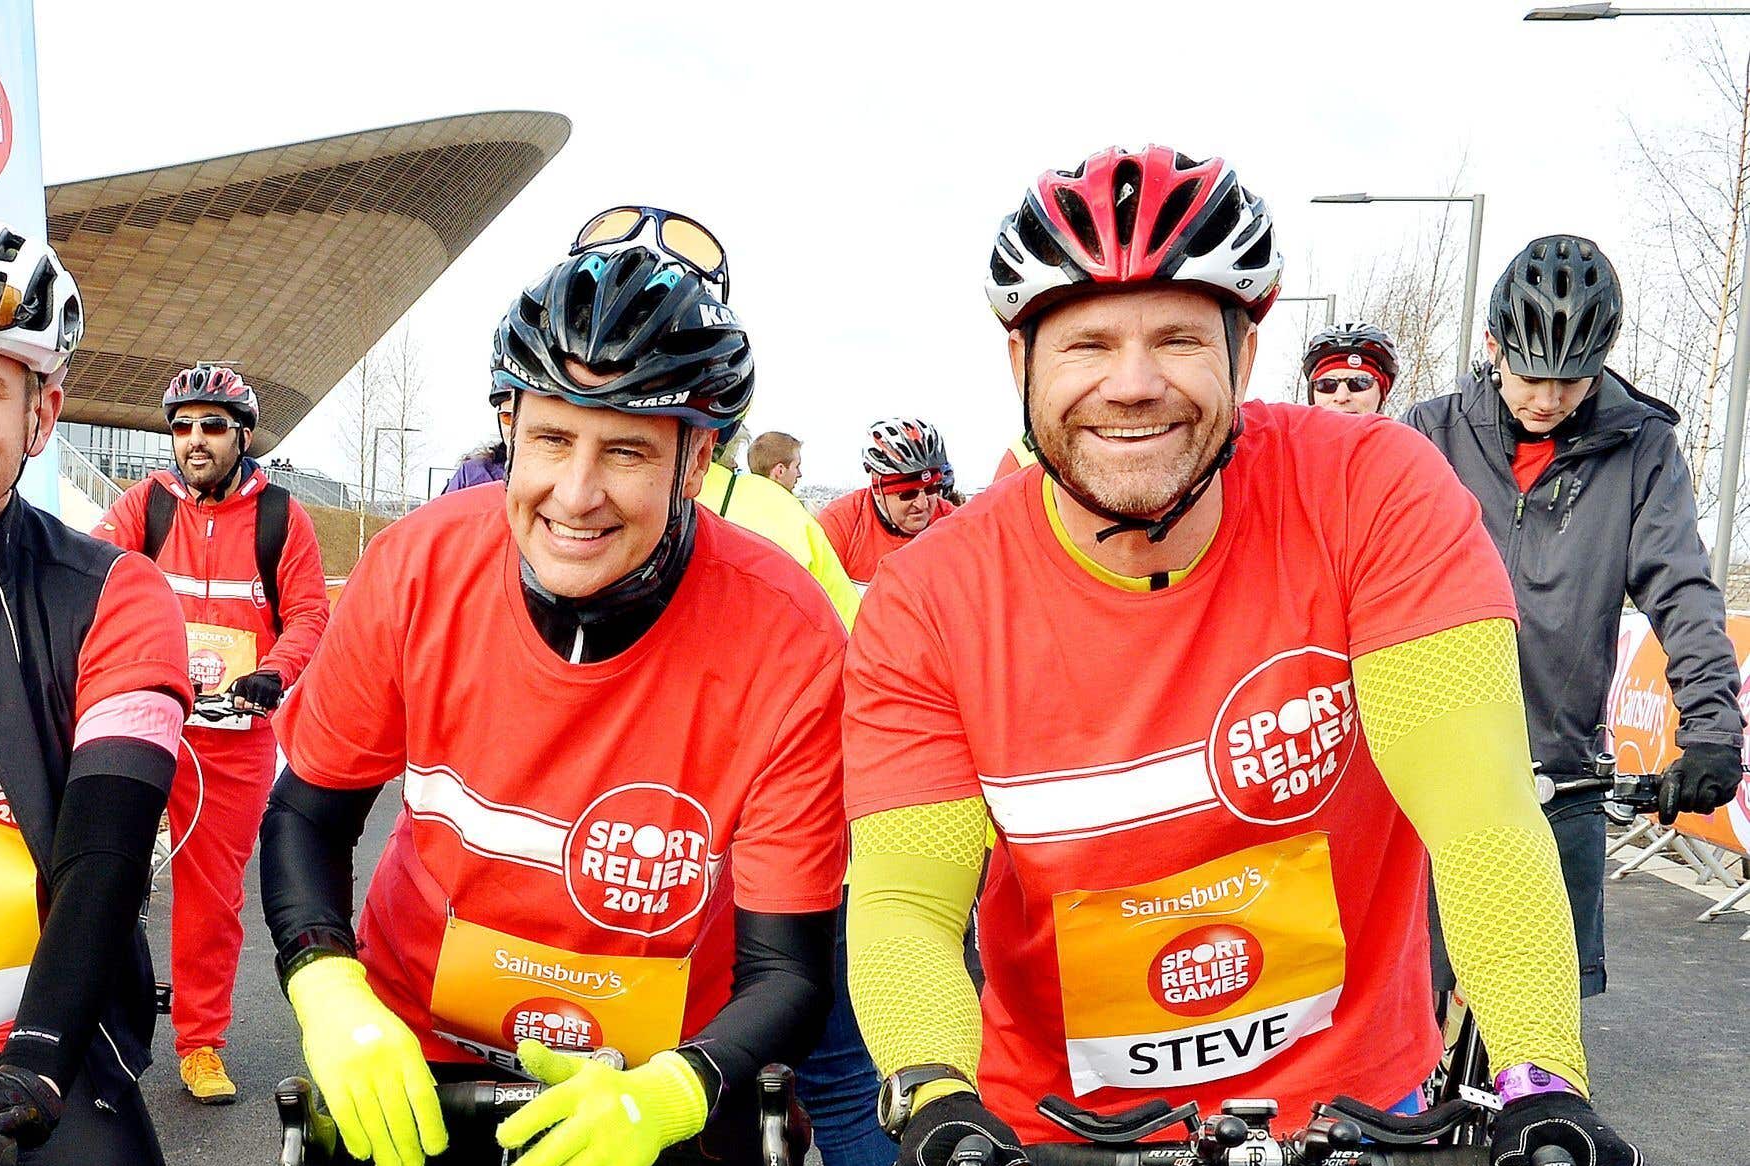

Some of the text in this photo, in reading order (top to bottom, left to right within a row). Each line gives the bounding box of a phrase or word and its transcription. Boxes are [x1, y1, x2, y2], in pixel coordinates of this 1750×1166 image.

[627, 391, 690, 407] KASK
[1227, 679, 1352, 758] SPORT
[1231, 703, 1353, 789] RELIEF
[1271, 752, 1337, 804] 2014
[586, 820, 706, 862] SPORT
[581, 850, 702, 890] RELIEF
[603, 888, 670, 914] 2014
[1121, 866, 1263, 919] Sainsbury's
[493, 949, 622, 991] Sainsbury's
[1161, 938, 1248, 971] SPORT
[1161, 957, 1249, 990] RELIEF
[1165, 973, 1249, 1004] GAMES
[513, 1024, 591, 1047] RELIEF
[515, 1010, 591, 1034] SPORT
[1128, 1012, 1289, 1076] STEVE
